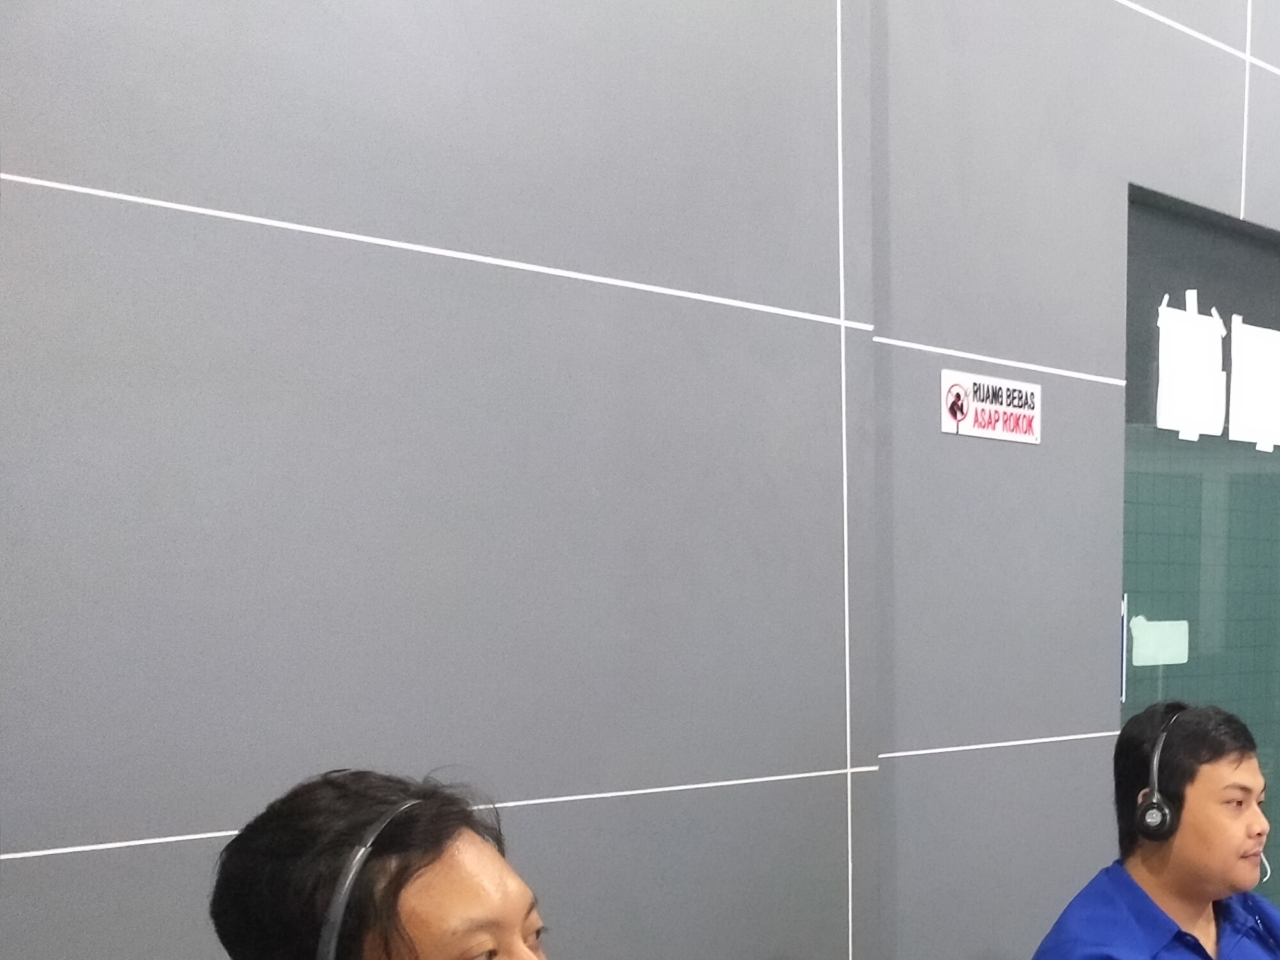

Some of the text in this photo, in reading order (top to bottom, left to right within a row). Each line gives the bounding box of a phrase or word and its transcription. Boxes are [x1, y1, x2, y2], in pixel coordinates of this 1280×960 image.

[973, 382, 1035, 410] RUANG BEBAS
[973, 407, 1035, 436] ASAP ROKOK
